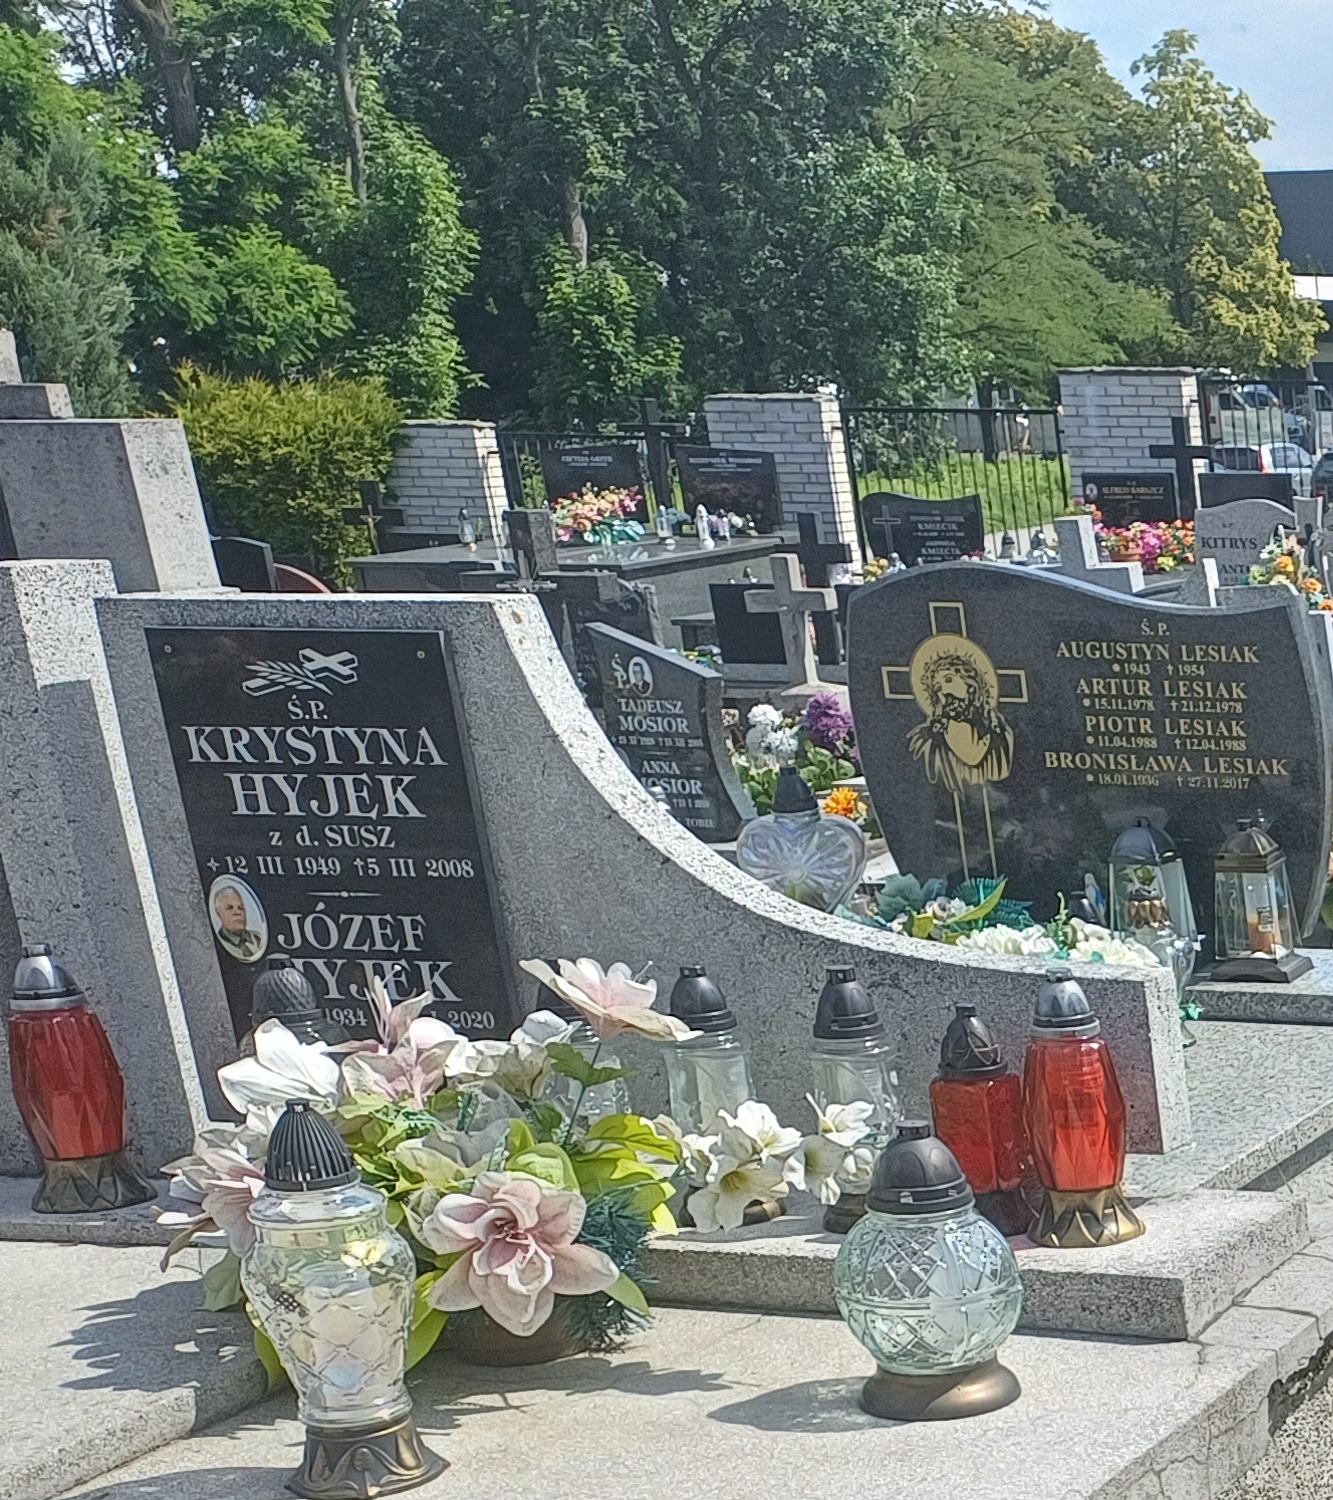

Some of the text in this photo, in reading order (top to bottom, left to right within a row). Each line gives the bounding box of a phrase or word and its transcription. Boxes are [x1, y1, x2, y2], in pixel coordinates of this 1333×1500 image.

[1201, 536, 1258, 550] KITRYS
[1056, 641, 1260, 664] AUGUSTYN LESIAK
[1123, 663, 1205, 677] 1943 1954
[1076, 678, 1248, 699] ARTUR LESIAK
[287, 694, 328, 720] Ś.P.
[617, 699, 684, 715] TADEUSZ
[1093, 698, 1243, 714] 15.11.1978 21.12.1978
[618, 715, 691, 735] MOSIOR
[1084, 715, 1248, 738] PIOTR LESIAK
[180, 725, 449, 766] KRYSTYNA
[1098, 736, 1247, 751] 11.04.1988 12.04.1988
[641, 760, 681, 776] ANNA
[1044, 751, 1290, 776] BRONISŁAWA LESIAK
[1187, 776, 1250, 790] 27.11.2017
[223, 772, 427, 820] HYJEK
[268, 824, 396, 848] z d. SUSZ
[225, 855, 249, 875] 12
[256, 855, 284, 876] III
[294, 856, 342, 877] 1949
[389, 857, 417, 878] III
[425, 859, 476, 879] 2008
[277, 901, 428, 953] JÓZEF
[447, 1010, 496, 1031] 2020
